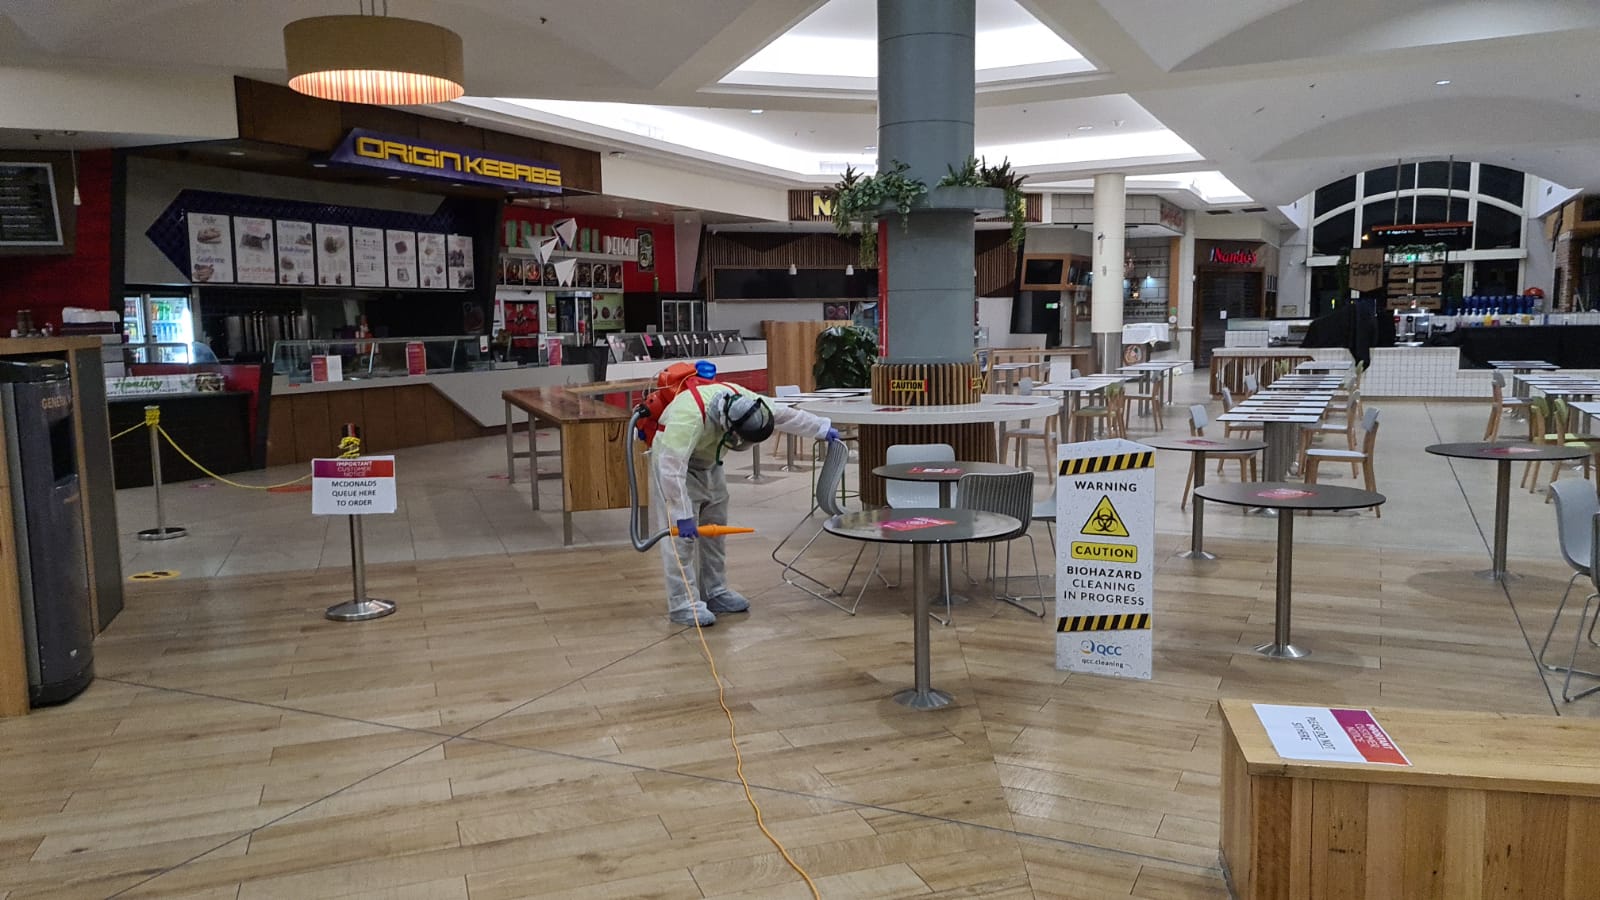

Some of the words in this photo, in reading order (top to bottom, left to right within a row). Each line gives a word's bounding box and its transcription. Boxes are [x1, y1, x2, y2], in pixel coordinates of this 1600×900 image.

[356, 136, 461, 172] ORIGIN
[464, 155, 562, 186] KEBABS
[891, 381, 923, 390] CAUTION
[331, 480, 377, 488] MCDONALDS
[1074, 480, 1137, 493] WARNING
[1075, 545, 1134, 558] CAUTION
[1066, 565, 1142, 580] BIOHAZARD
[1072, 579, 1136, 592] CLEANING
[1063, 590, 1077, 600] IN
[1080, 592, 1145, 606] PROGRESS
[1096, 643, 1123, 657] QCC
[1081, 658, 1124, 669] qcc.cleaning
